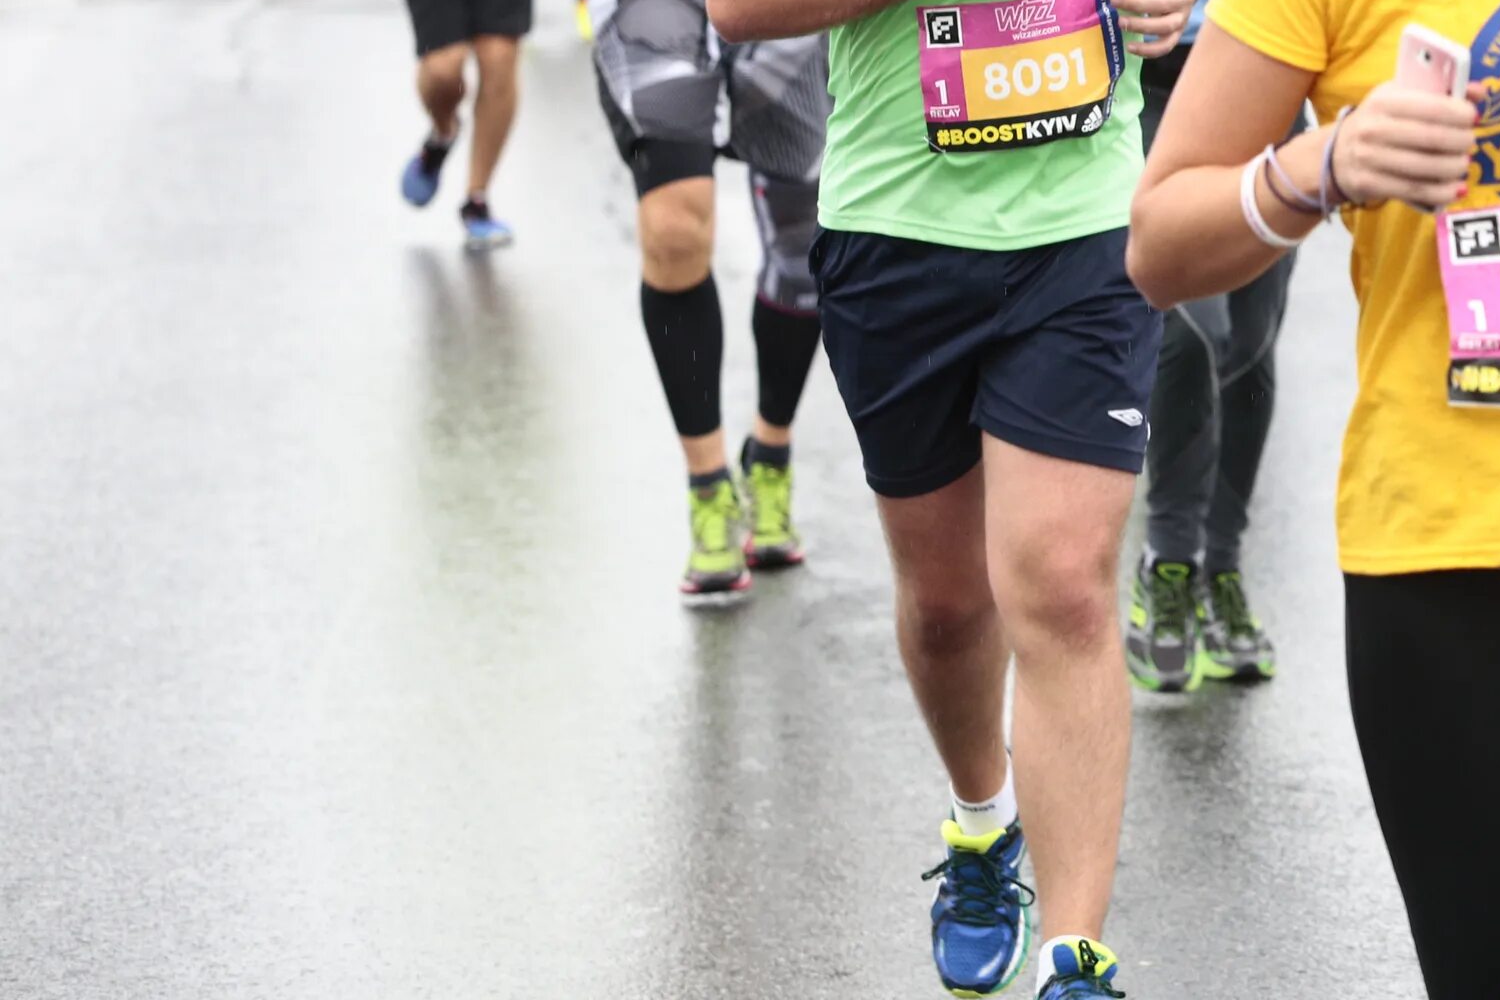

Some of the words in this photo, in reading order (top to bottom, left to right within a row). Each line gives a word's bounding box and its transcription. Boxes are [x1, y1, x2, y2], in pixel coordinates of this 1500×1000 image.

[1012, 25, 1060, 40] wizzair.com
[984, 47, 1087, 100] 8091
[934, 80, 948, 104] 1
[930, 108, 960, 118] RELAY
[936, 114, 1077, 146] #BOOSTKYIV
[1468, 300, 1487, 331] 1
